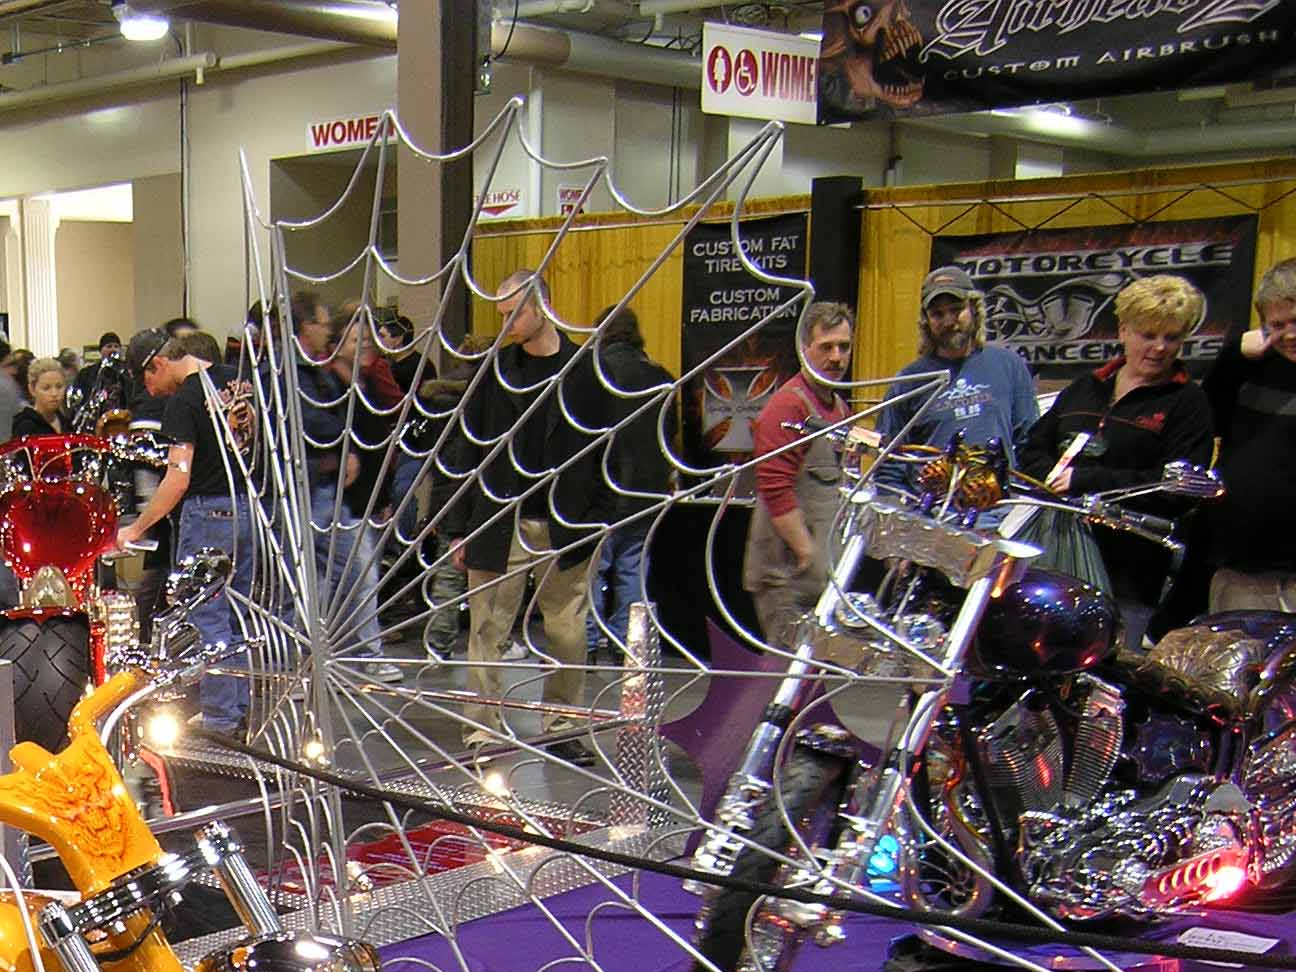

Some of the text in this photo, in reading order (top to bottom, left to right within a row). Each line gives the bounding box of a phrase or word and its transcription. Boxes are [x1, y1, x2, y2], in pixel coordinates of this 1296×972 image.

[1095, 29, 1279, 65] AIRBRUSH
[761, 50, 819, 102] WOME
[692, 235, 799, 257] CUSTOM FAT
[705, 255, 788, 273] TIRE KITS
[709, 288, 781, 305] CUSTOM
[1008, 336, 1224, 364] ANCEMTS
